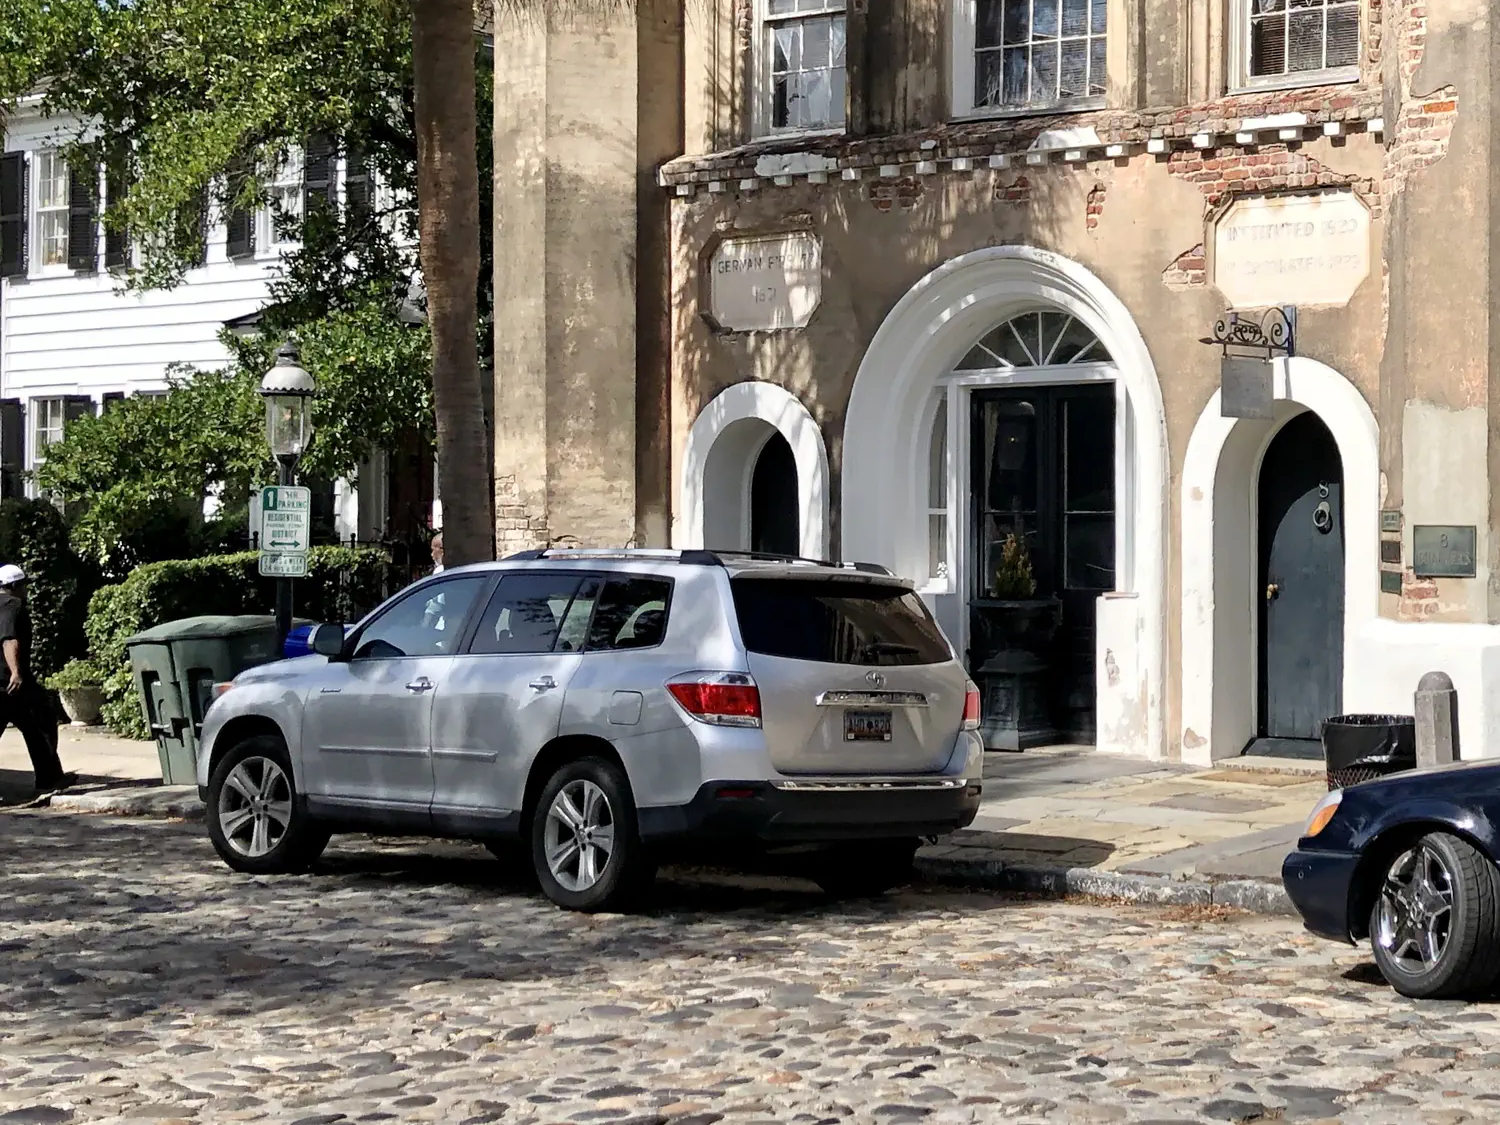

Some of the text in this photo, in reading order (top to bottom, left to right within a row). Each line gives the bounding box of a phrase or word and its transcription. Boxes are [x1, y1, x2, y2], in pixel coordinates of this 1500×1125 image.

[718, 257, 762, 274] GERMAN
[1319, 480, 1328, 497] 8
[267, 491, 274, 508] 1
[278, 500, 307, 509] PARKING
